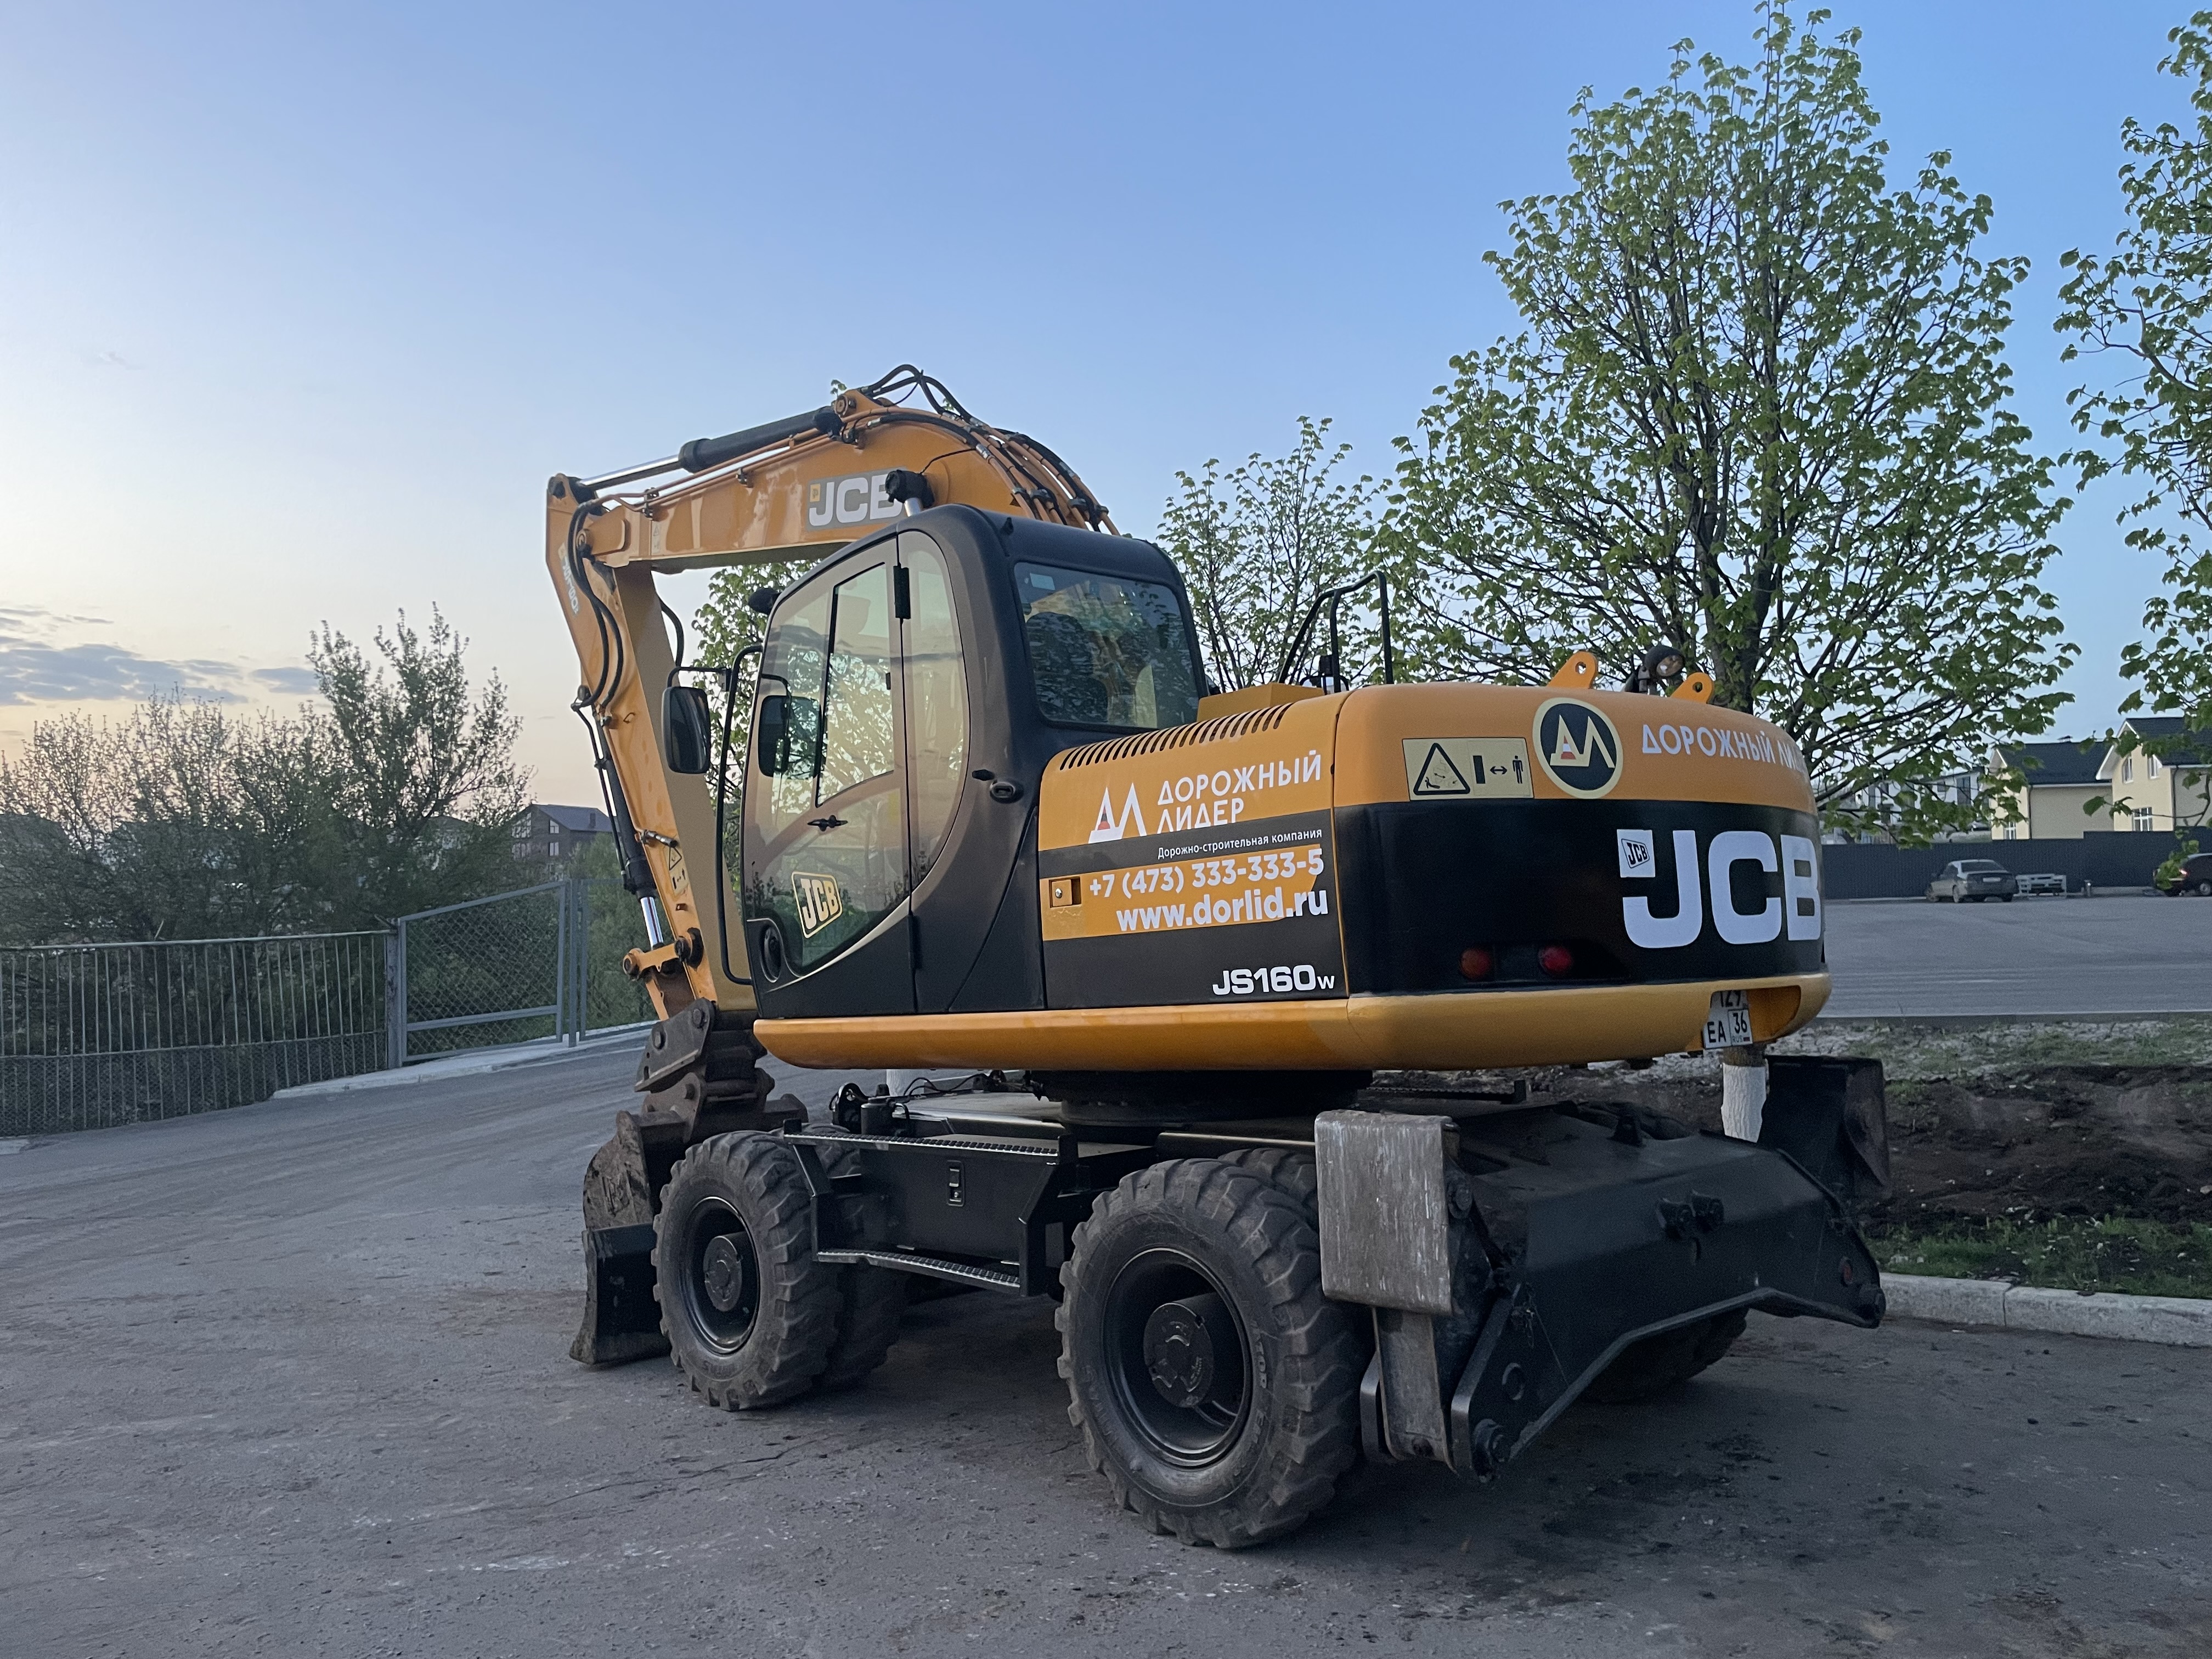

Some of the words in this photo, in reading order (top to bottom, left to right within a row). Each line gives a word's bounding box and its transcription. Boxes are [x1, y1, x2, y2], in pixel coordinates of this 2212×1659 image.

[809, 474, 902, 526] JCB
[1642, 724, 1776, 764] ДОРОЖНЫЙ
[1157, 750, 1321, 805] ДОРОЖНЫЙ
[1156, 798, 1244, 834] ЛИДЕР
[1158, 835, 1269, 860] Дорожно-строительная
[1271, 829, 1322, 843] компания
[1626, 842, 1648, 865] JCB
[1090, 873, 1115, 898] +7
[1122, 866, 1184, 899] (473)
[1192, 848, 1324, 888] 333-333-5
[1622, 830, 1821, 949] JCB
[800, 878, 839, 930] JCB
[1116, 887, 1328, 932] www.dorlid.ru
[1731, 1035, 1743, 1043] RUS
[1732, 1012, 1747, 1034] 36
